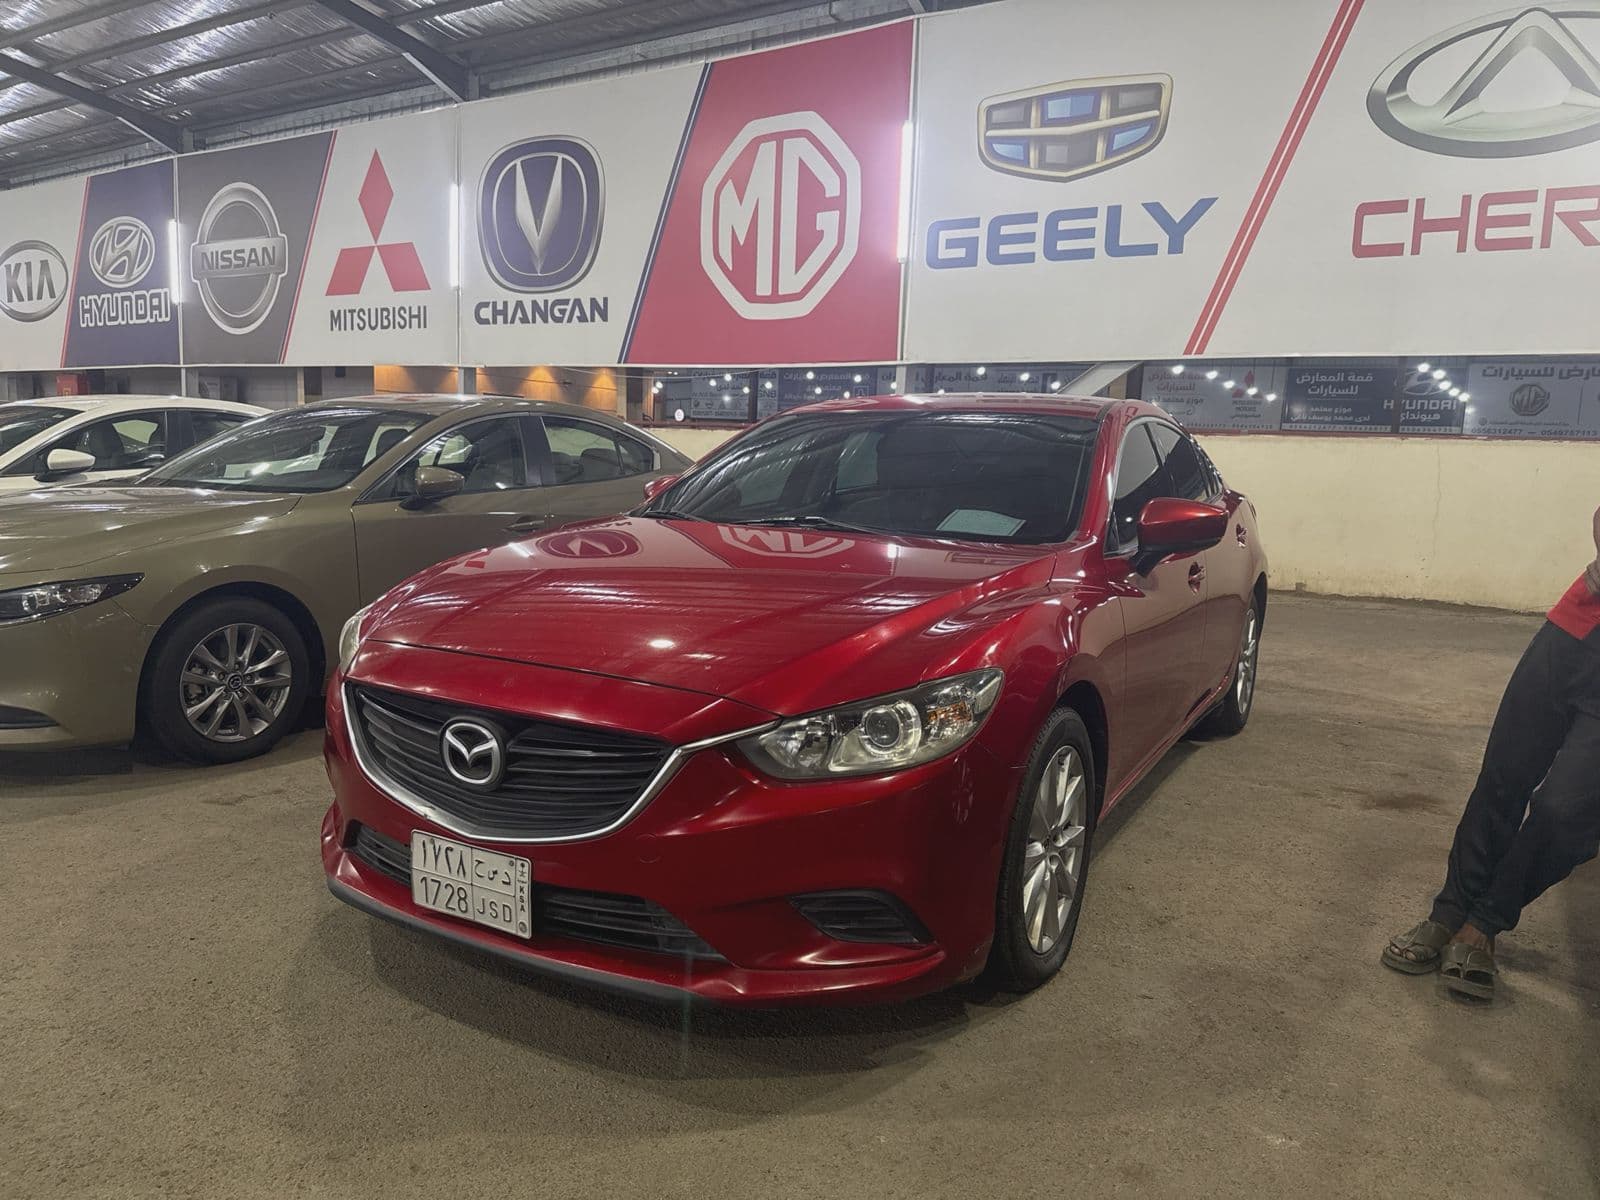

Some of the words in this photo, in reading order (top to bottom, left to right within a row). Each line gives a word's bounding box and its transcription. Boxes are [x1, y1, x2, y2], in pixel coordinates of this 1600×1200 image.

[717, 137, 842, 299] MG
[926, 197, 1218, 270] GEELY
[200, 244, 277, 271] NISSAN
[5, 259, 56, 303] KIA
[79, 288, 171, 328] HYUNDAI
[329, 305, 428, 332] MITSUBISHI
[474, 296, 609, 326] CHANGAN
[1296, 372, 1345, 384] المعارض
[1481, 365, 1555, 381] للسيارات
[1307, 384, 1359, 397] للسيارات
[420, 875, 469, 914] 1728
[476, 898, 512, 923] JSD
